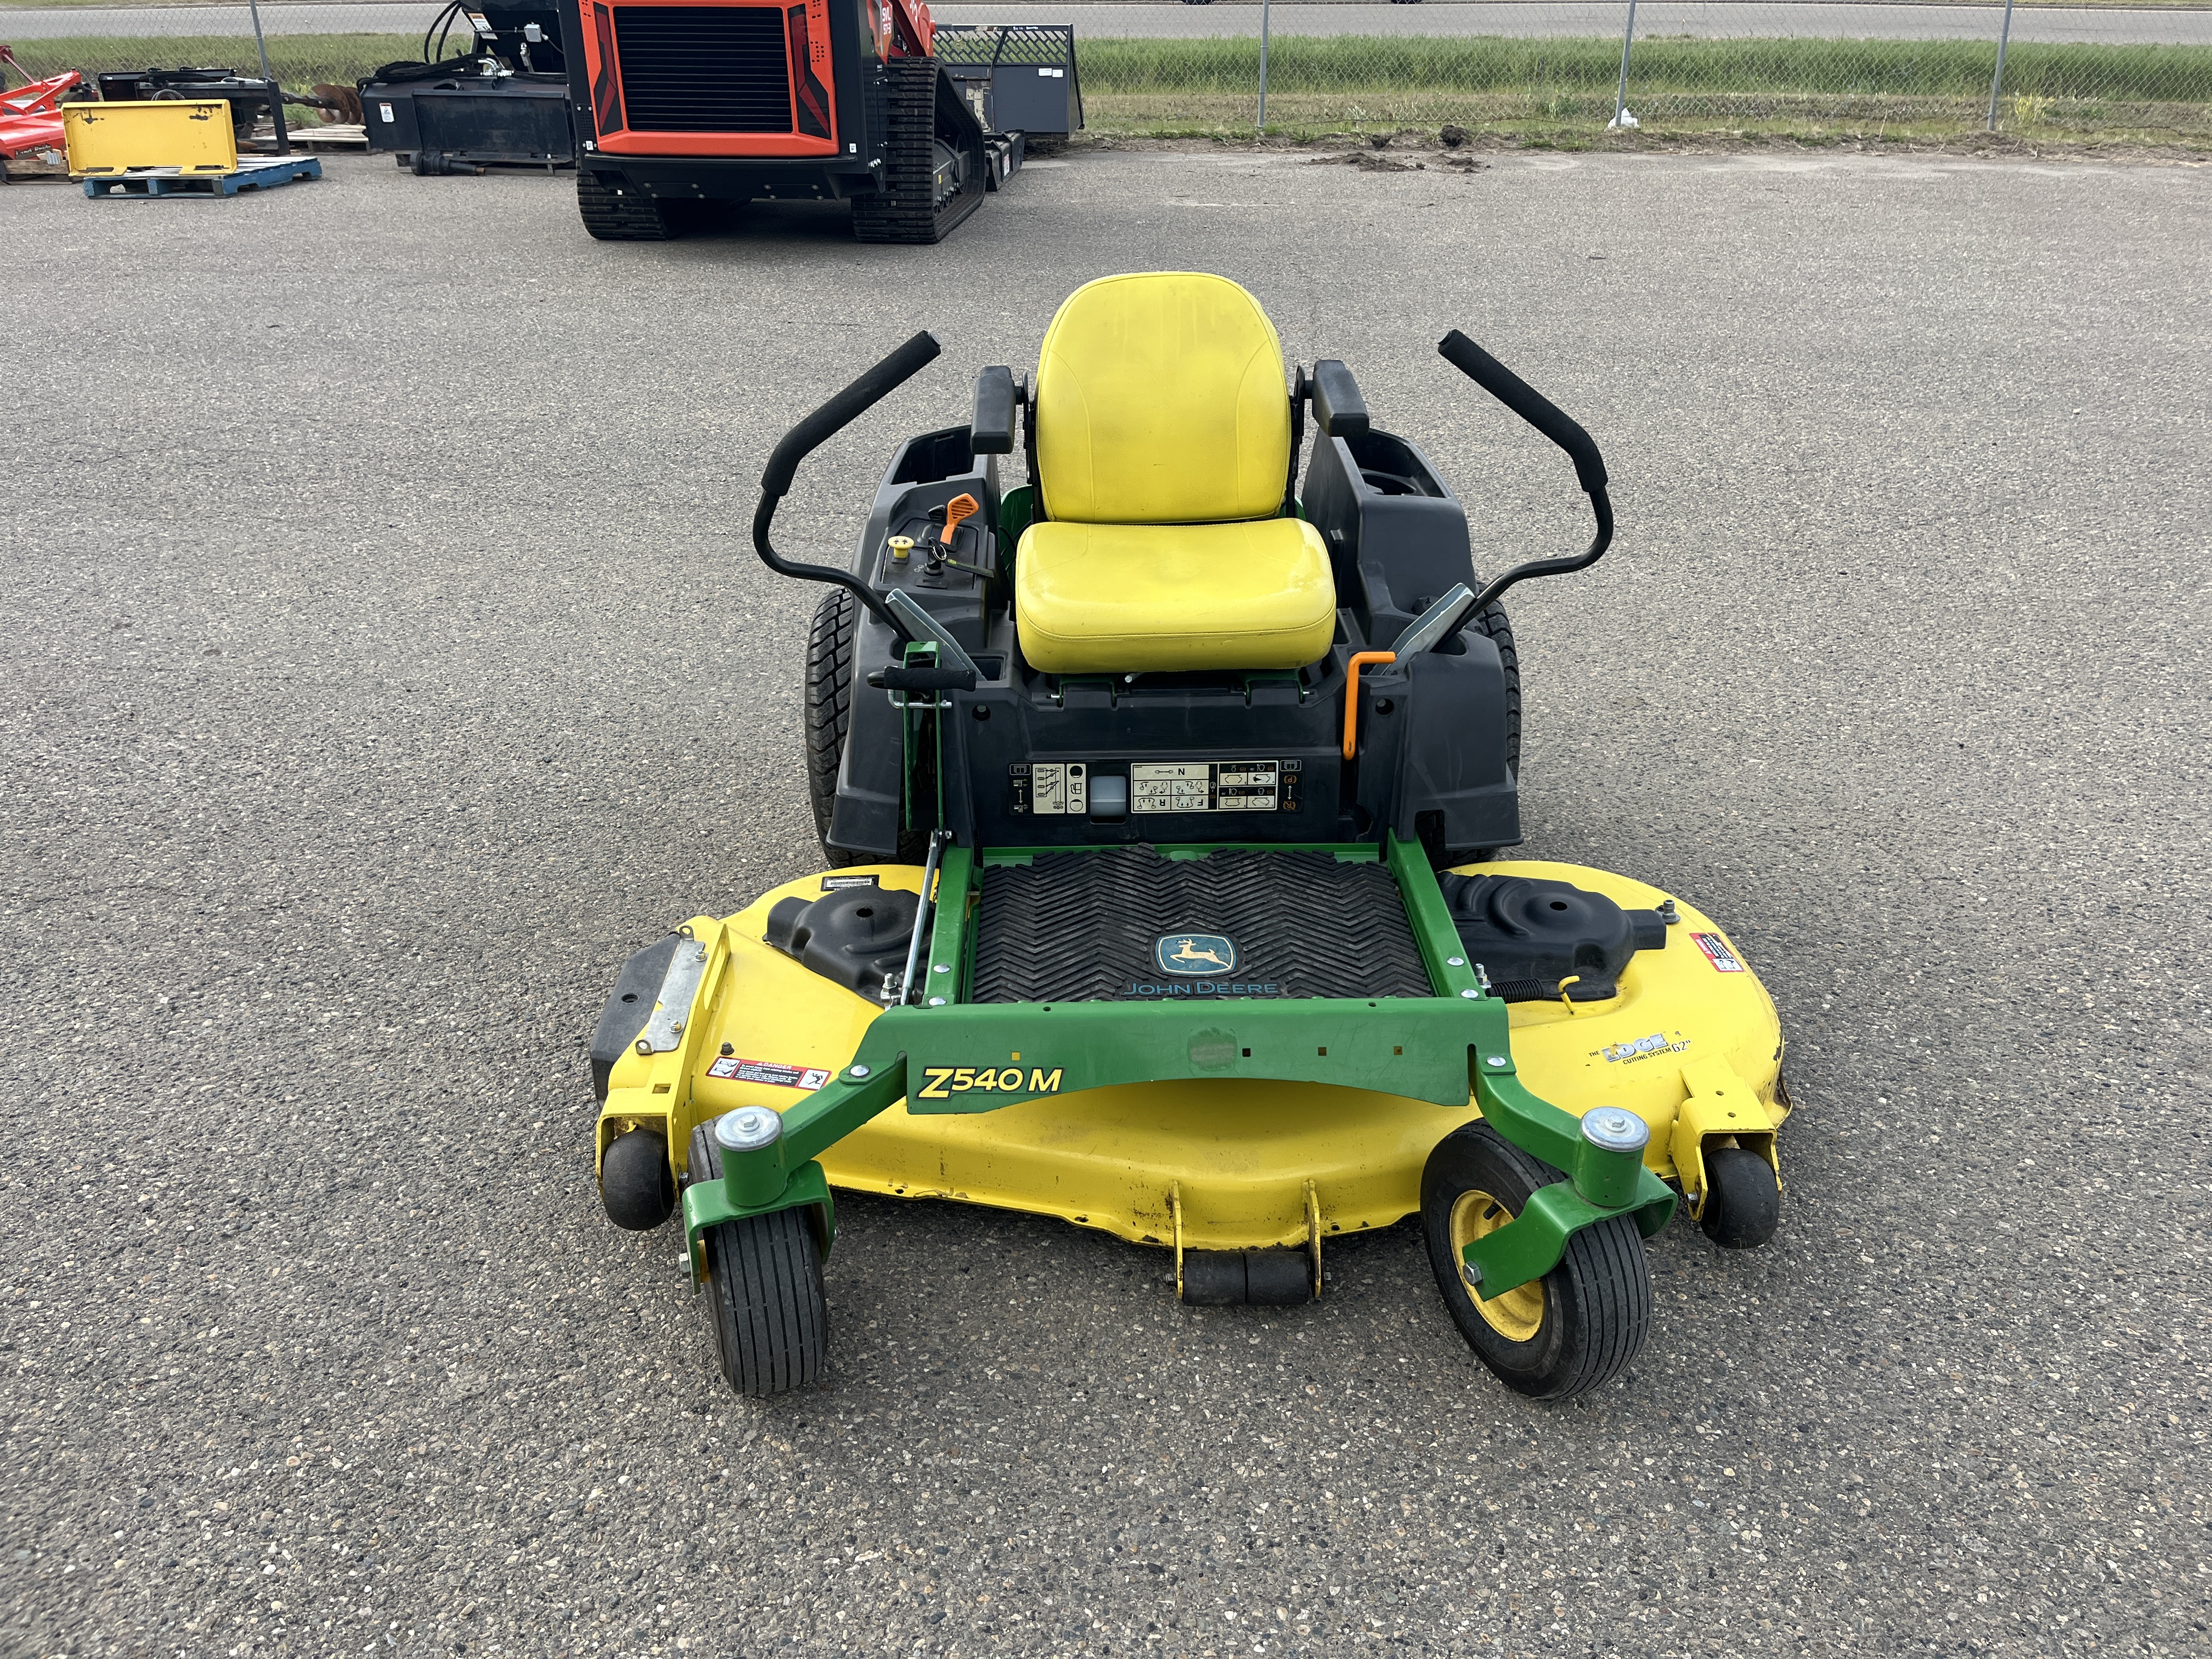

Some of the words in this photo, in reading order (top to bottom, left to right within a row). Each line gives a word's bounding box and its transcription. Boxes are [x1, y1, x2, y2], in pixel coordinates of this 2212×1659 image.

[1124, 983, 1191, 995] JOHN
[1195, 981, 1279, 994] DEERE
[1622, 1054, 1648, 1065] CUTTING
[1648, 1047, 1672, 1058] SYSTEM
[917, 1066, 1024, 1100] Z540
[1027, 1067, 1064, 1093] M
